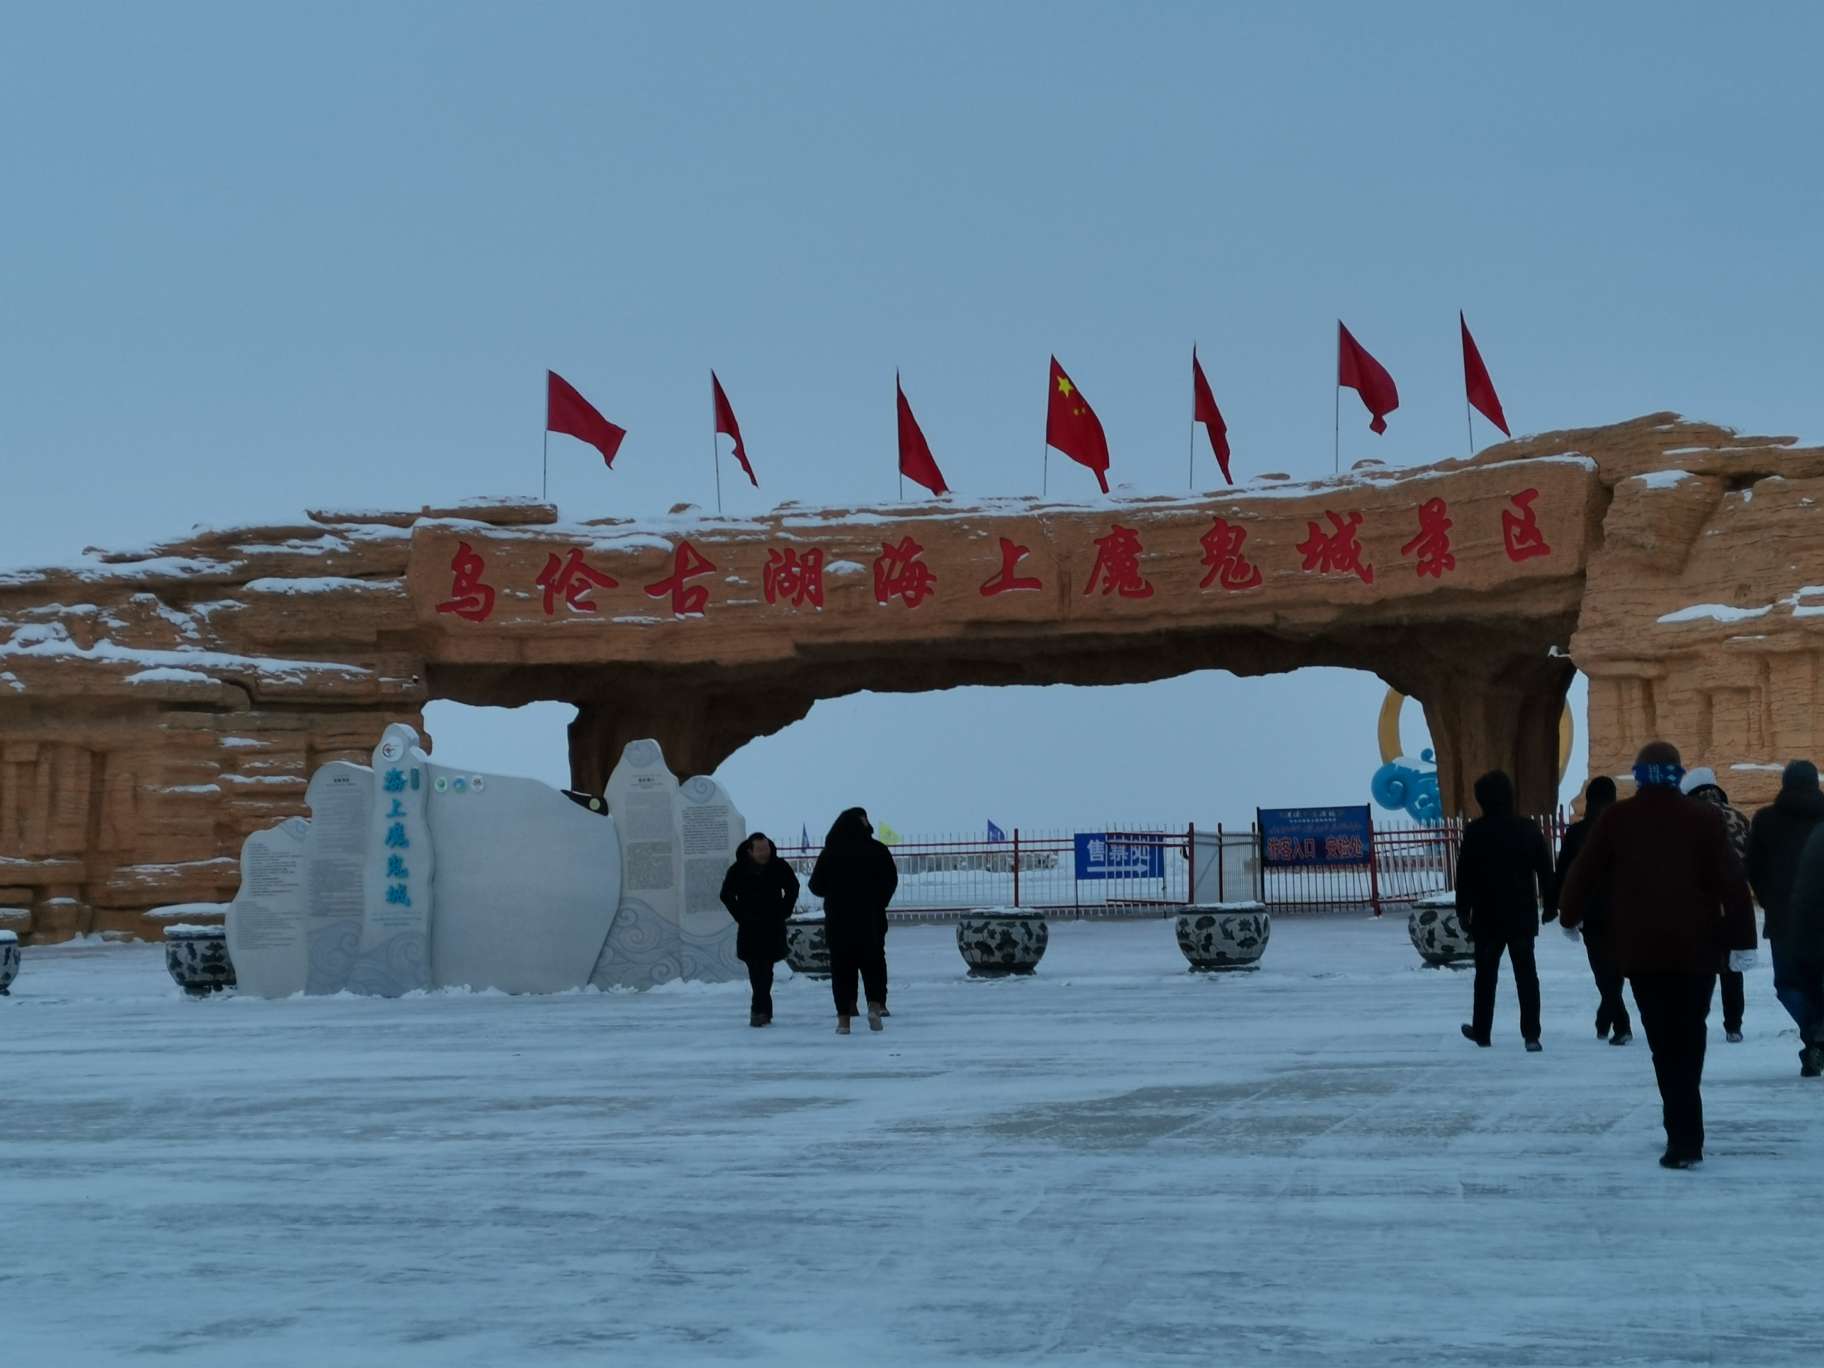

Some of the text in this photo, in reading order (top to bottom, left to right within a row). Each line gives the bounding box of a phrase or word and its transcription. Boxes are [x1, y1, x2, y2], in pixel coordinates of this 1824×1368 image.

[435, 487, 1551, 622] 乌伦古湖海上魔鬼城景区
[383, 767, 412, 907] 海上魔鬼城
